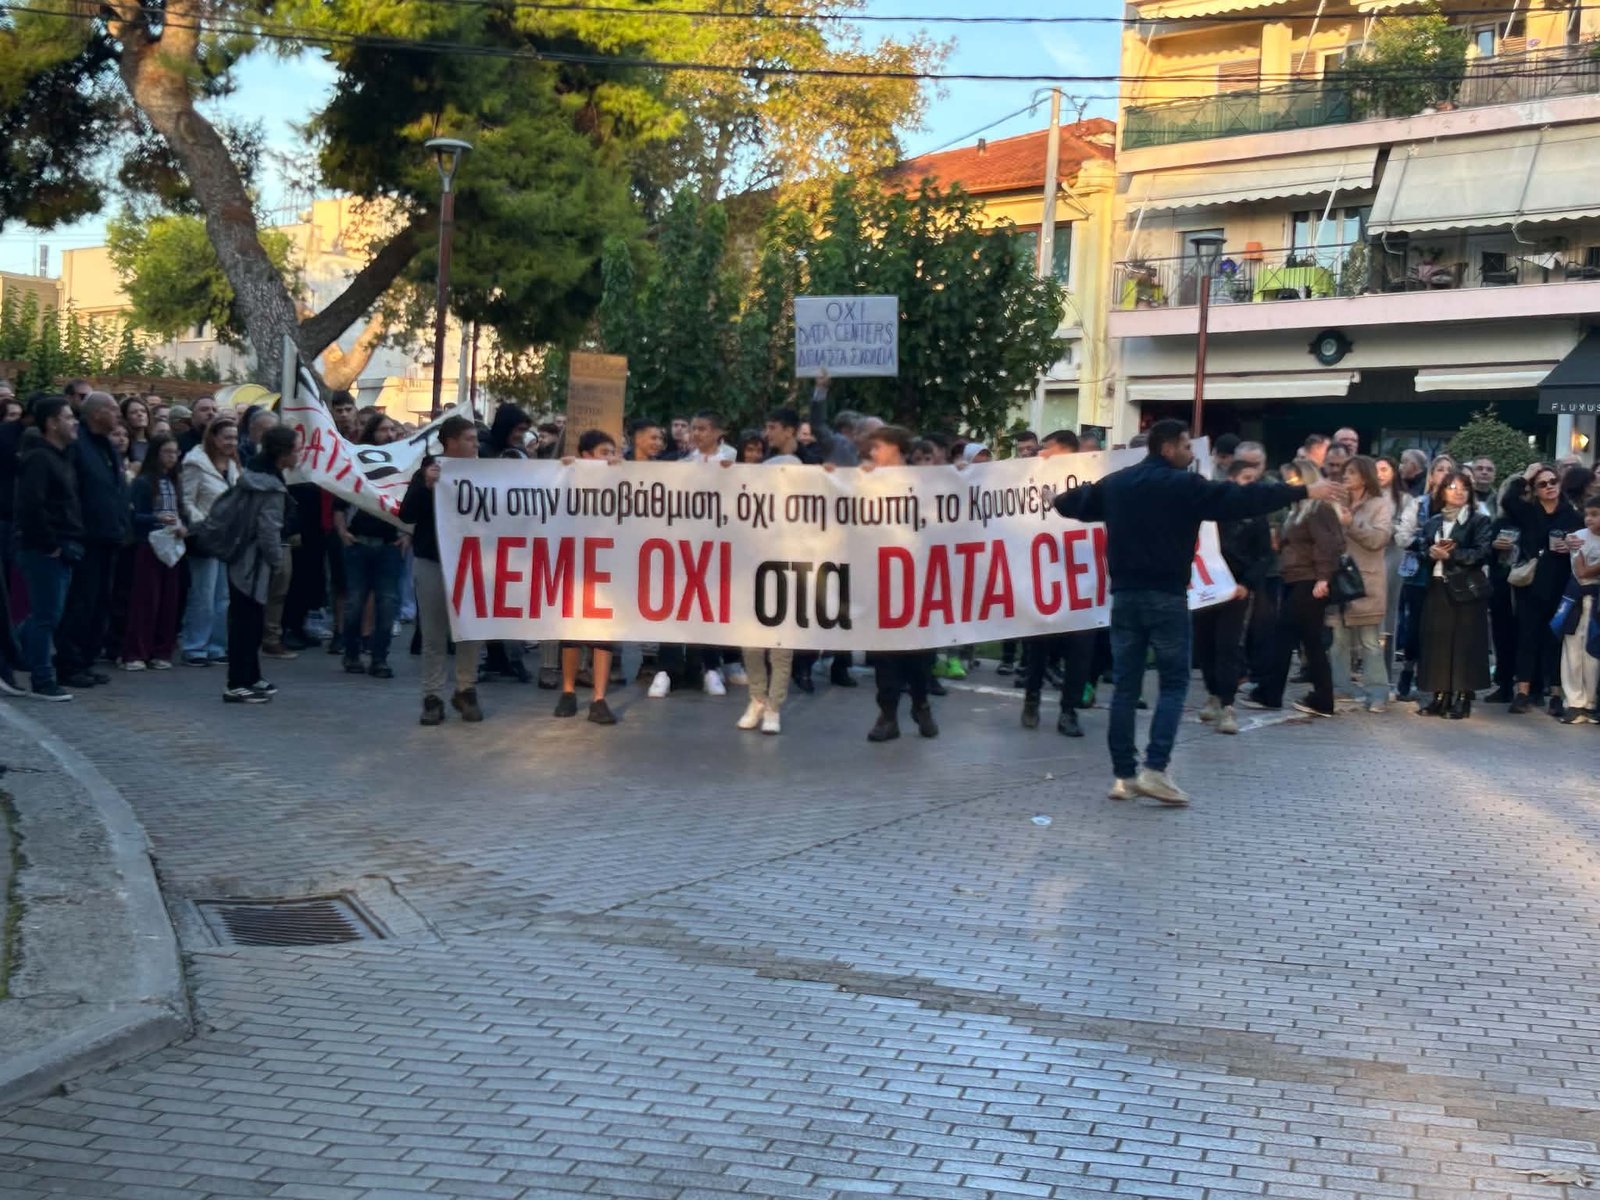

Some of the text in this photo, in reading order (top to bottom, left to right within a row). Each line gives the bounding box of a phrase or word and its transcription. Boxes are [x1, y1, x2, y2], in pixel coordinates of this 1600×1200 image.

[453, 478, 498, 522] Όχι
[506, 486, 561, 524] στην
[566, 480, 729, 528] υποβάθμιση,
[737, 483, 775, 529] όχι
[785, 494, 826, 532] στη
[834, 486, 928, 532] σιωπή,
[935, 493, 960, 523] το
[452, 536, 615, 619] ΛΕΜΕ
[637, 537, 733, 624] ΟΧΙ
[754, 560, 853, 630] στα
[877, 539, 1015, 629] DATA
